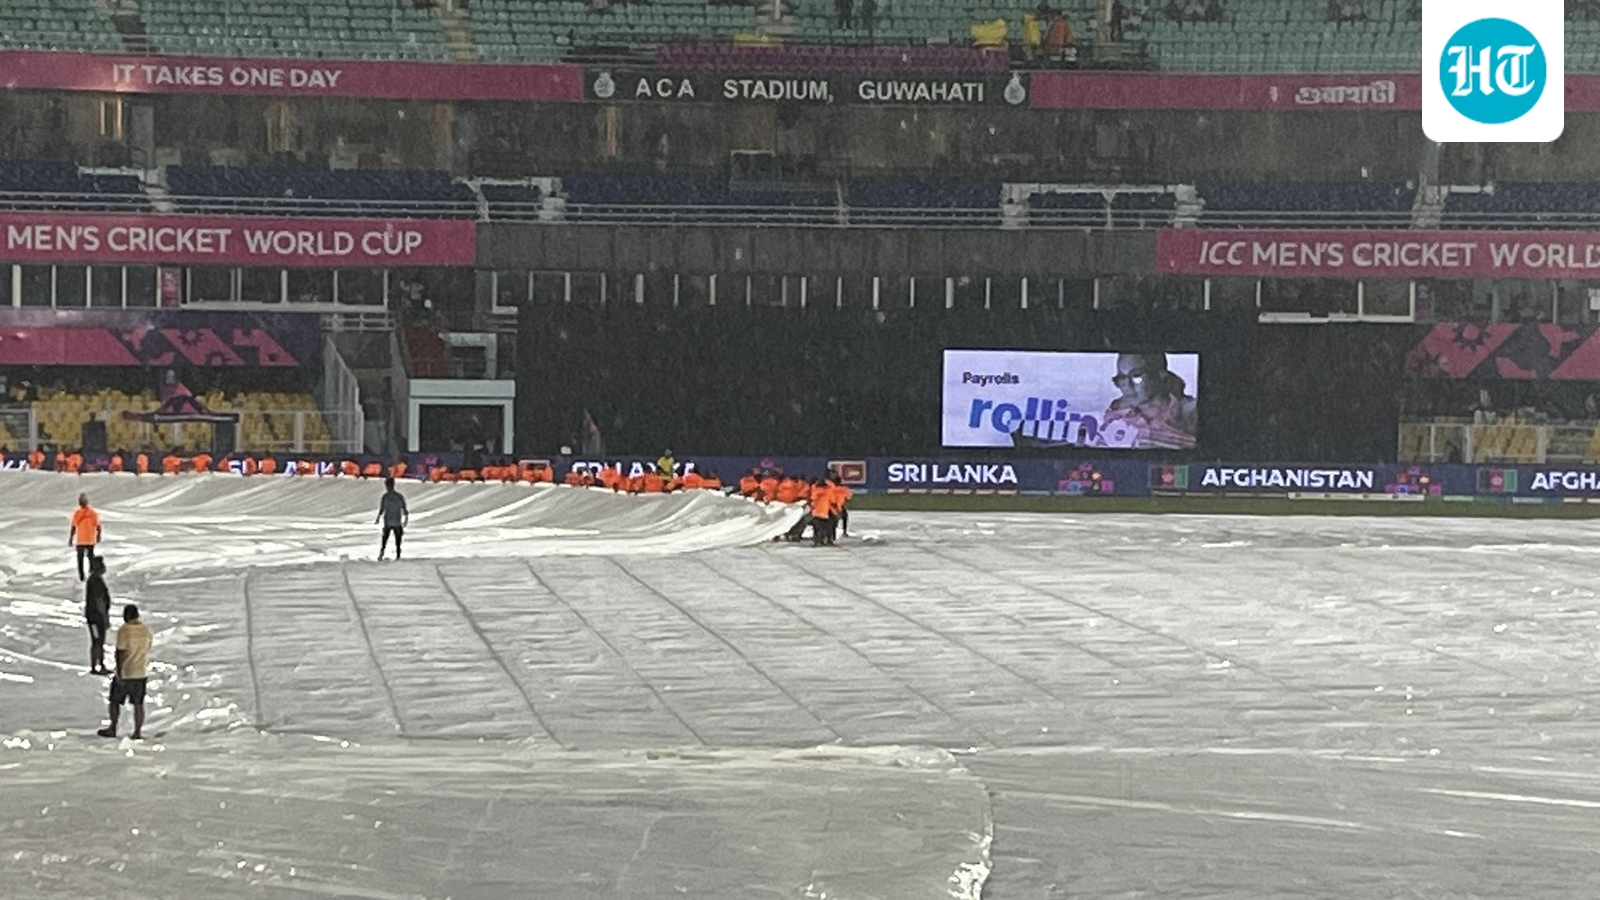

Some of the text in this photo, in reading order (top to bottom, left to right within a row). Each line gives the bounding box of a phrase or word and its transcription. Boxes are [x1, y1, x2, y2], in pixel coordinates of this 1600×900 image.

[112, 64, 342, 88] IT TAKES ONE DAY
[722, 79, 834, 103] STADIUM,
[857, 81, 984, 102] GUWAHATI
[7, 226, 423, 255] MEN'S CRICKET WORLD CUP
[1199, 240, 1247, 266] ICC
[1252, 241, 1344, 267] MEN'S
[1352, 242, 1477, 268] CRICKET
[962, 371, 1020, 387] Payrolls
[887, 463, 1018, 484] SRI LANKA
[1201, 468, 1374, 489] AFGHANISTAN
[1530, 470, 1600, 491] AFGH
